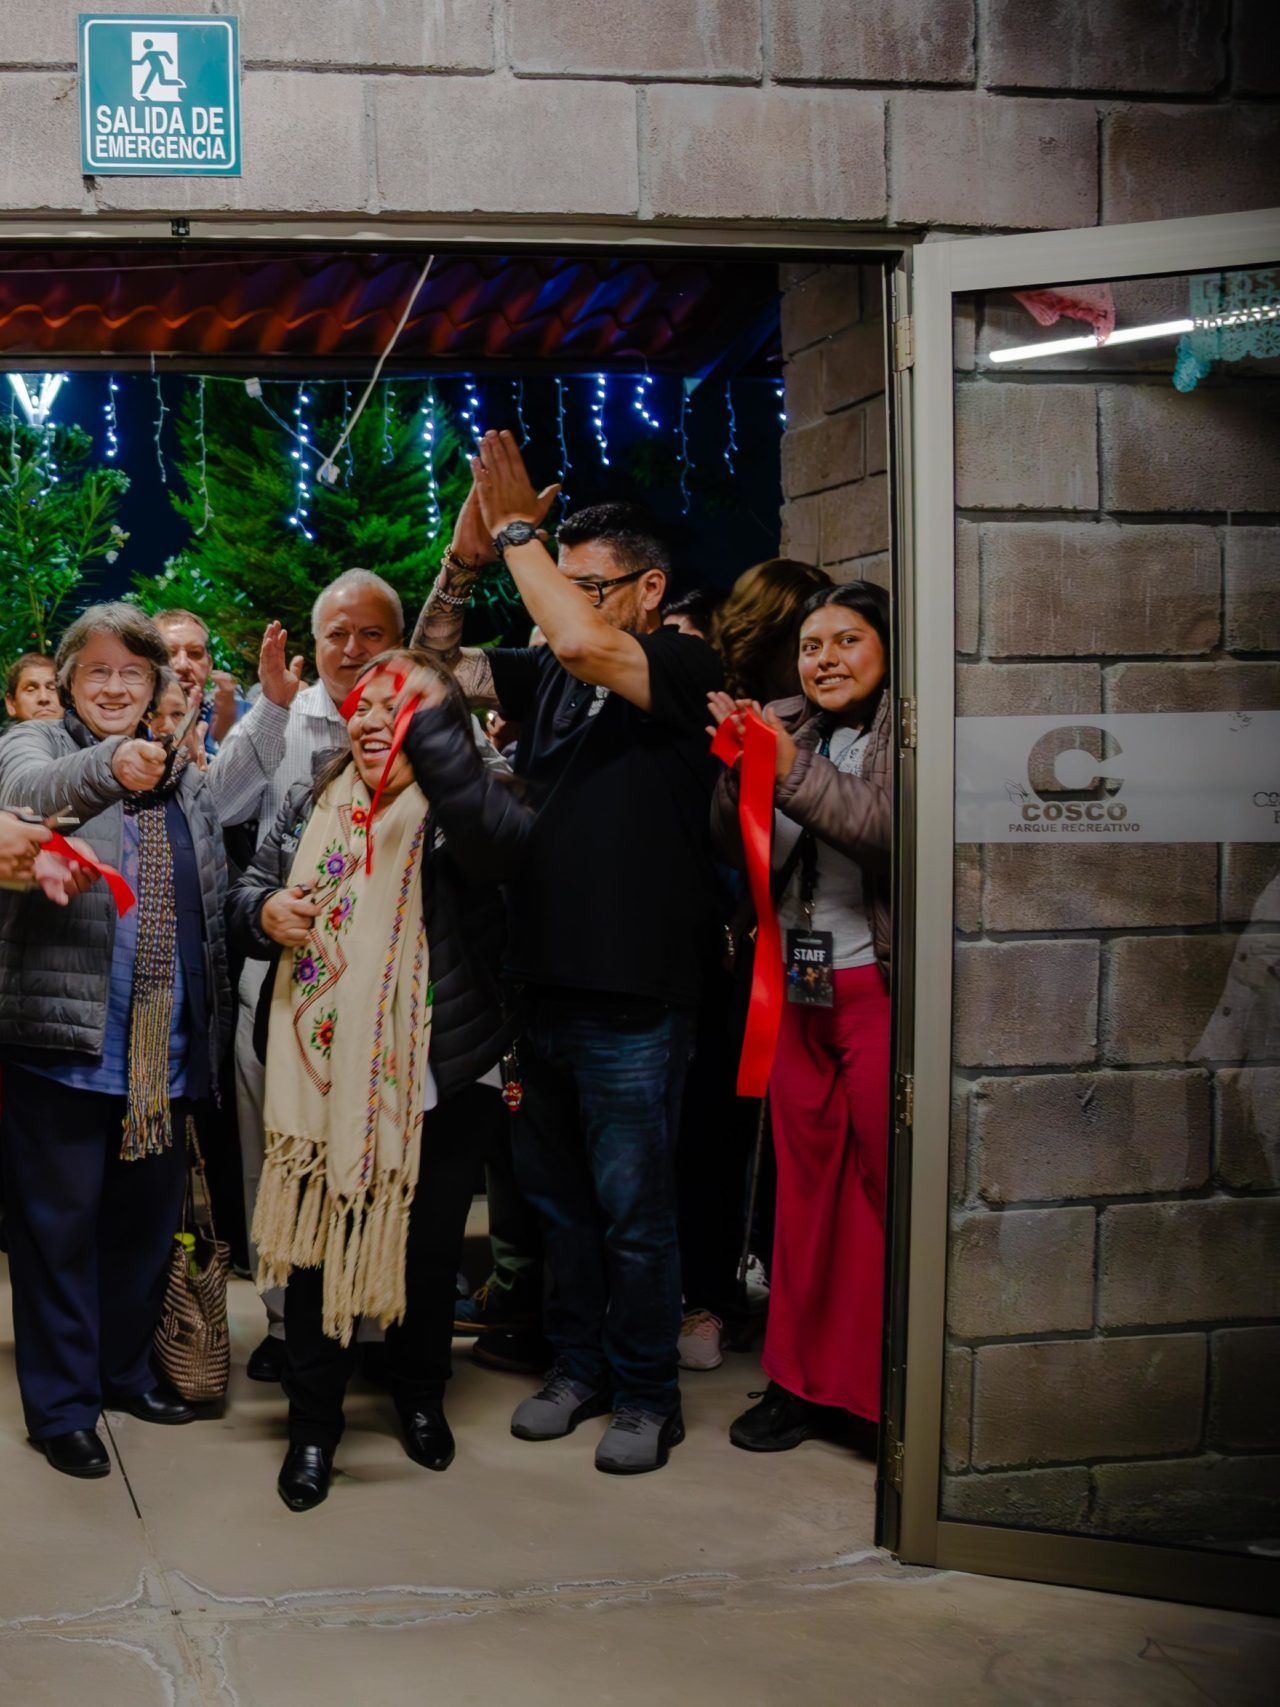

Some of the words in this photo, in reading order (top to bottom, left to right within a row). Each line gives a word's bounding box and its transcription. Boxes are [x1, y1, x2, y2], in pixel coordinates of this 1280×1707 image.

[96, 105, 186, 135] SALIDA
[191, 107, 225, 135] DE
[95, 135, 227, 160] EMERGENCIA
[1022, 802, 1128, 822] COSCO
[1008, 823, 1058, 833] PARQUE
[1061, 823, 1141, 833] RECREATIVO
[794, 948, 826, 962] STAFF
